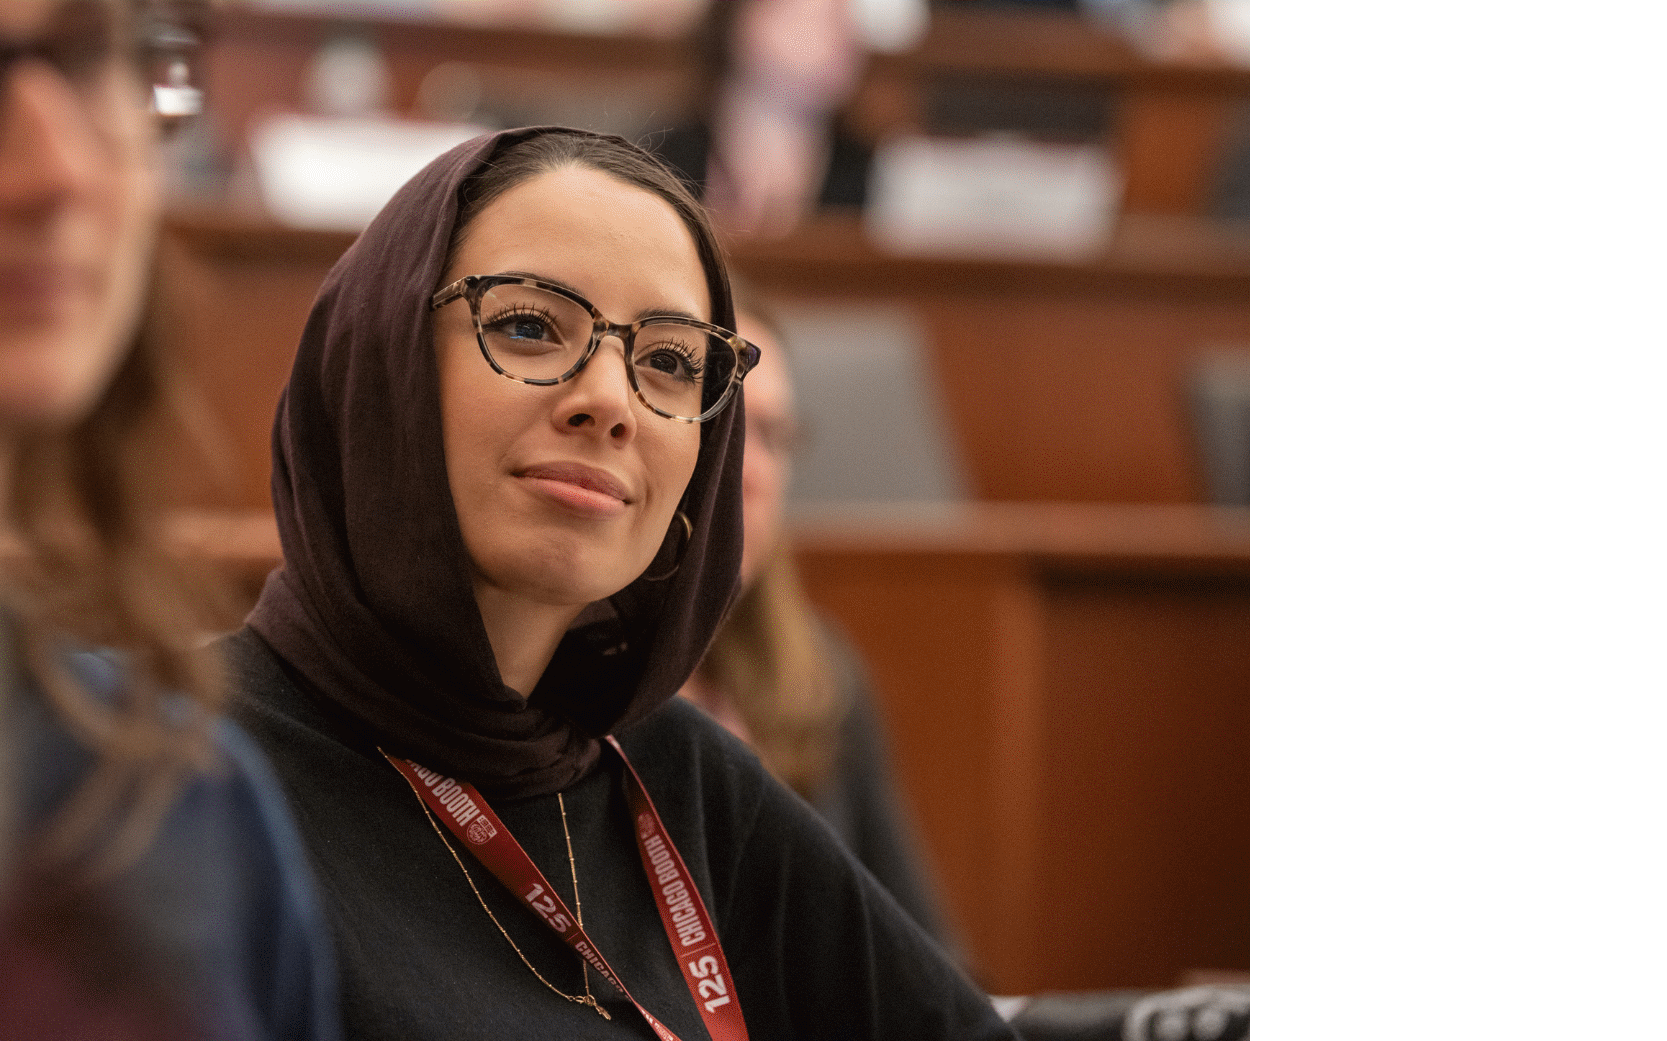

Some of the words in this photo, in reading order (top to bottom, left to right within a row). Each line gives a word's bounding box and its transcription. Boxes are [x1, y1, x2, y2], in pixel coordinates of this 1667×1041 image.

[431, 777, 481, 827] BOOTH
[643, 834, 680, 886] BOOTH
[524, 883, 572, 933] 125
[661, 879, 707, 947] CHICAGO
[688, 955, 731, 1014] 125
